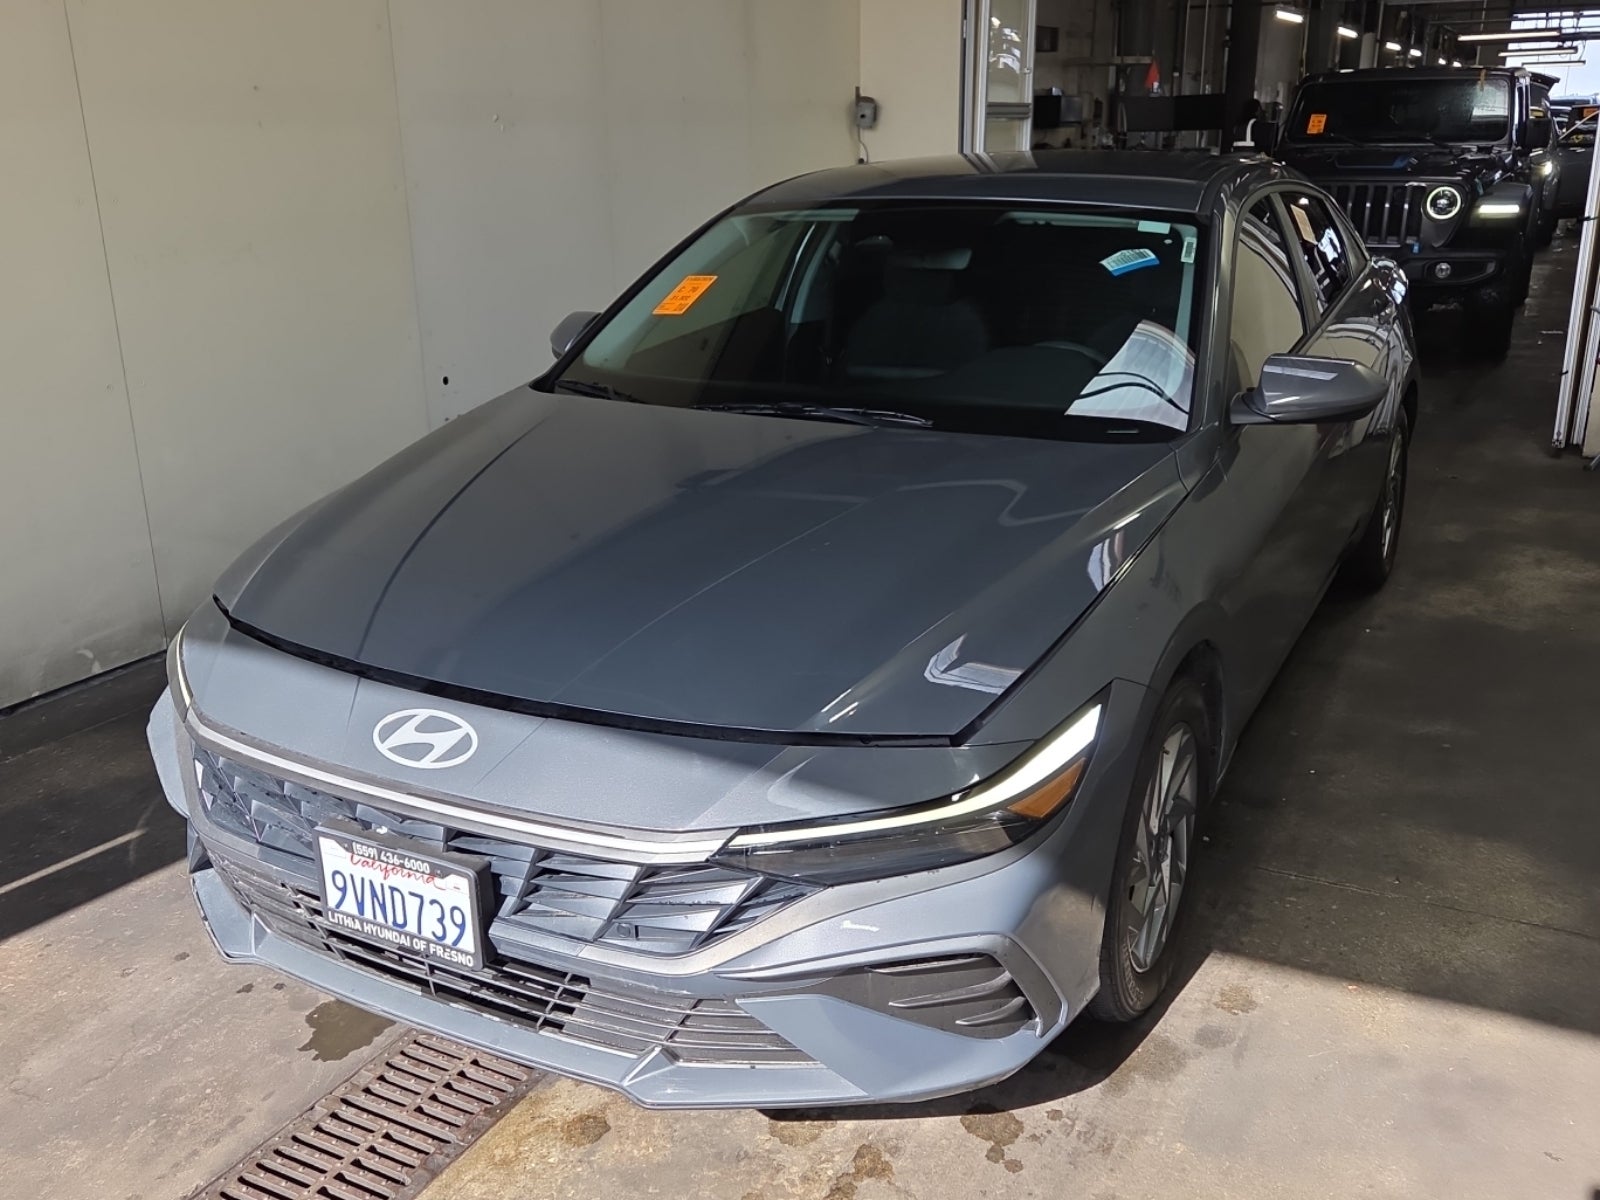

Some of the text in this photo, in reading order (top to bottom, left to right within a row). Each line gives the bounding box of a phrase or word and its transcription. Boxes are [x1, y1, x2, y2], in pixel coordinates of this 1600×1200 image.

[352, 842, 430, 875] (559) 436-6000
[331, 869, 466, 947] 9VND739
[328, 910, 474, 967] LITHIA HYUNDAI OF FRESNO
